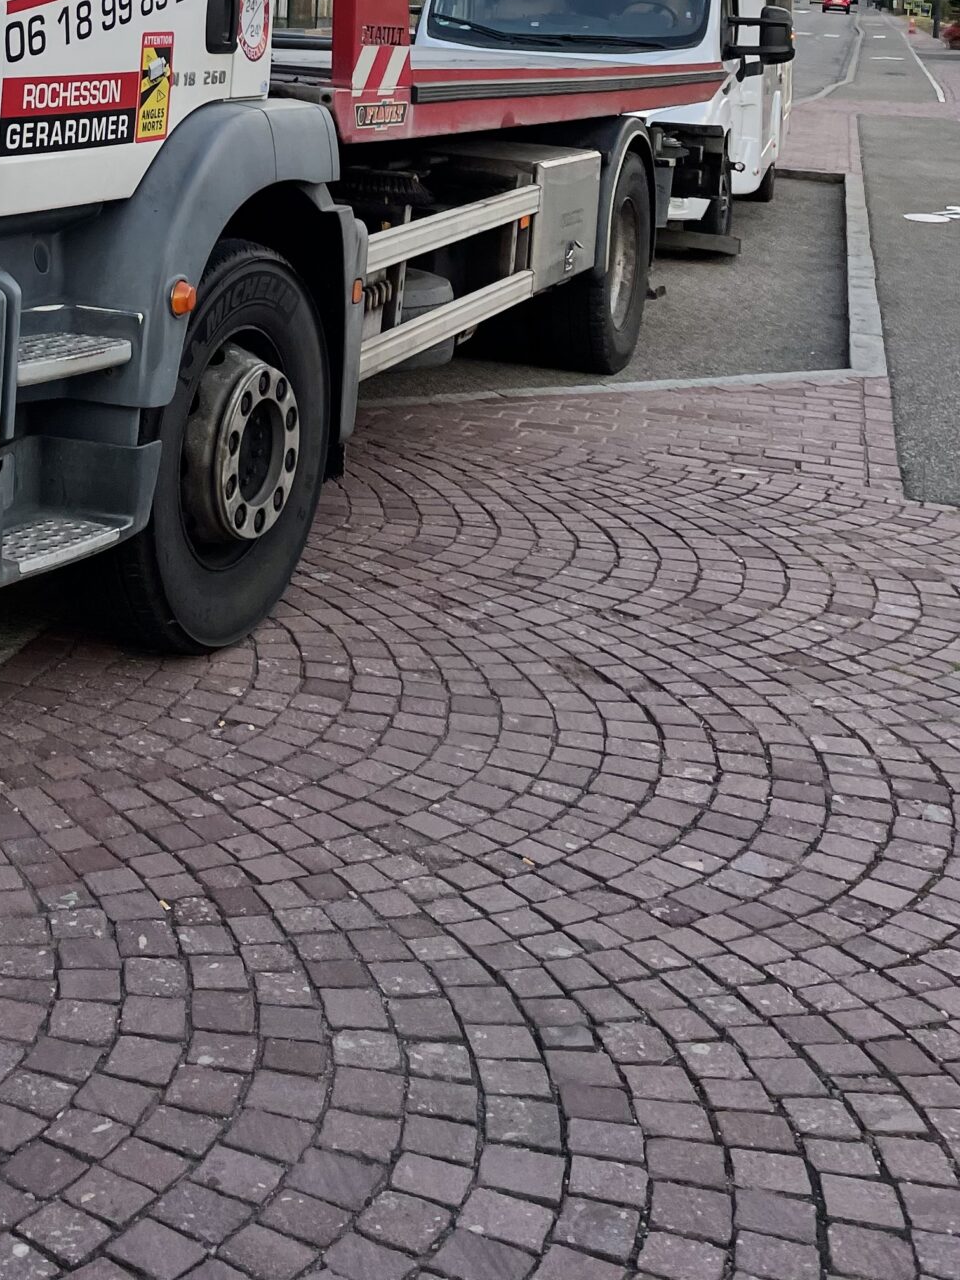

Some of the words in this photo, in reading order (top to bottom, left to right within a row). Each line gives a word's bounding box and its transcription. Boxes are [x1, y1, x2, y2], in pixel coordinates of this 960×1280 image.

[5, 15, 46, 63] 06
[58, 0, 93, 45] 18
[143, 35, 172, 45] ATTENTION
[23, 79, 121, 110] ROCHESSON
[142, 108, 165, 120] ANGLES
[142, 120, 163, 132] MORTS
[6, 114, 129, 150] GERARDMER
[207, 275, 300, 338] MICHELIN
